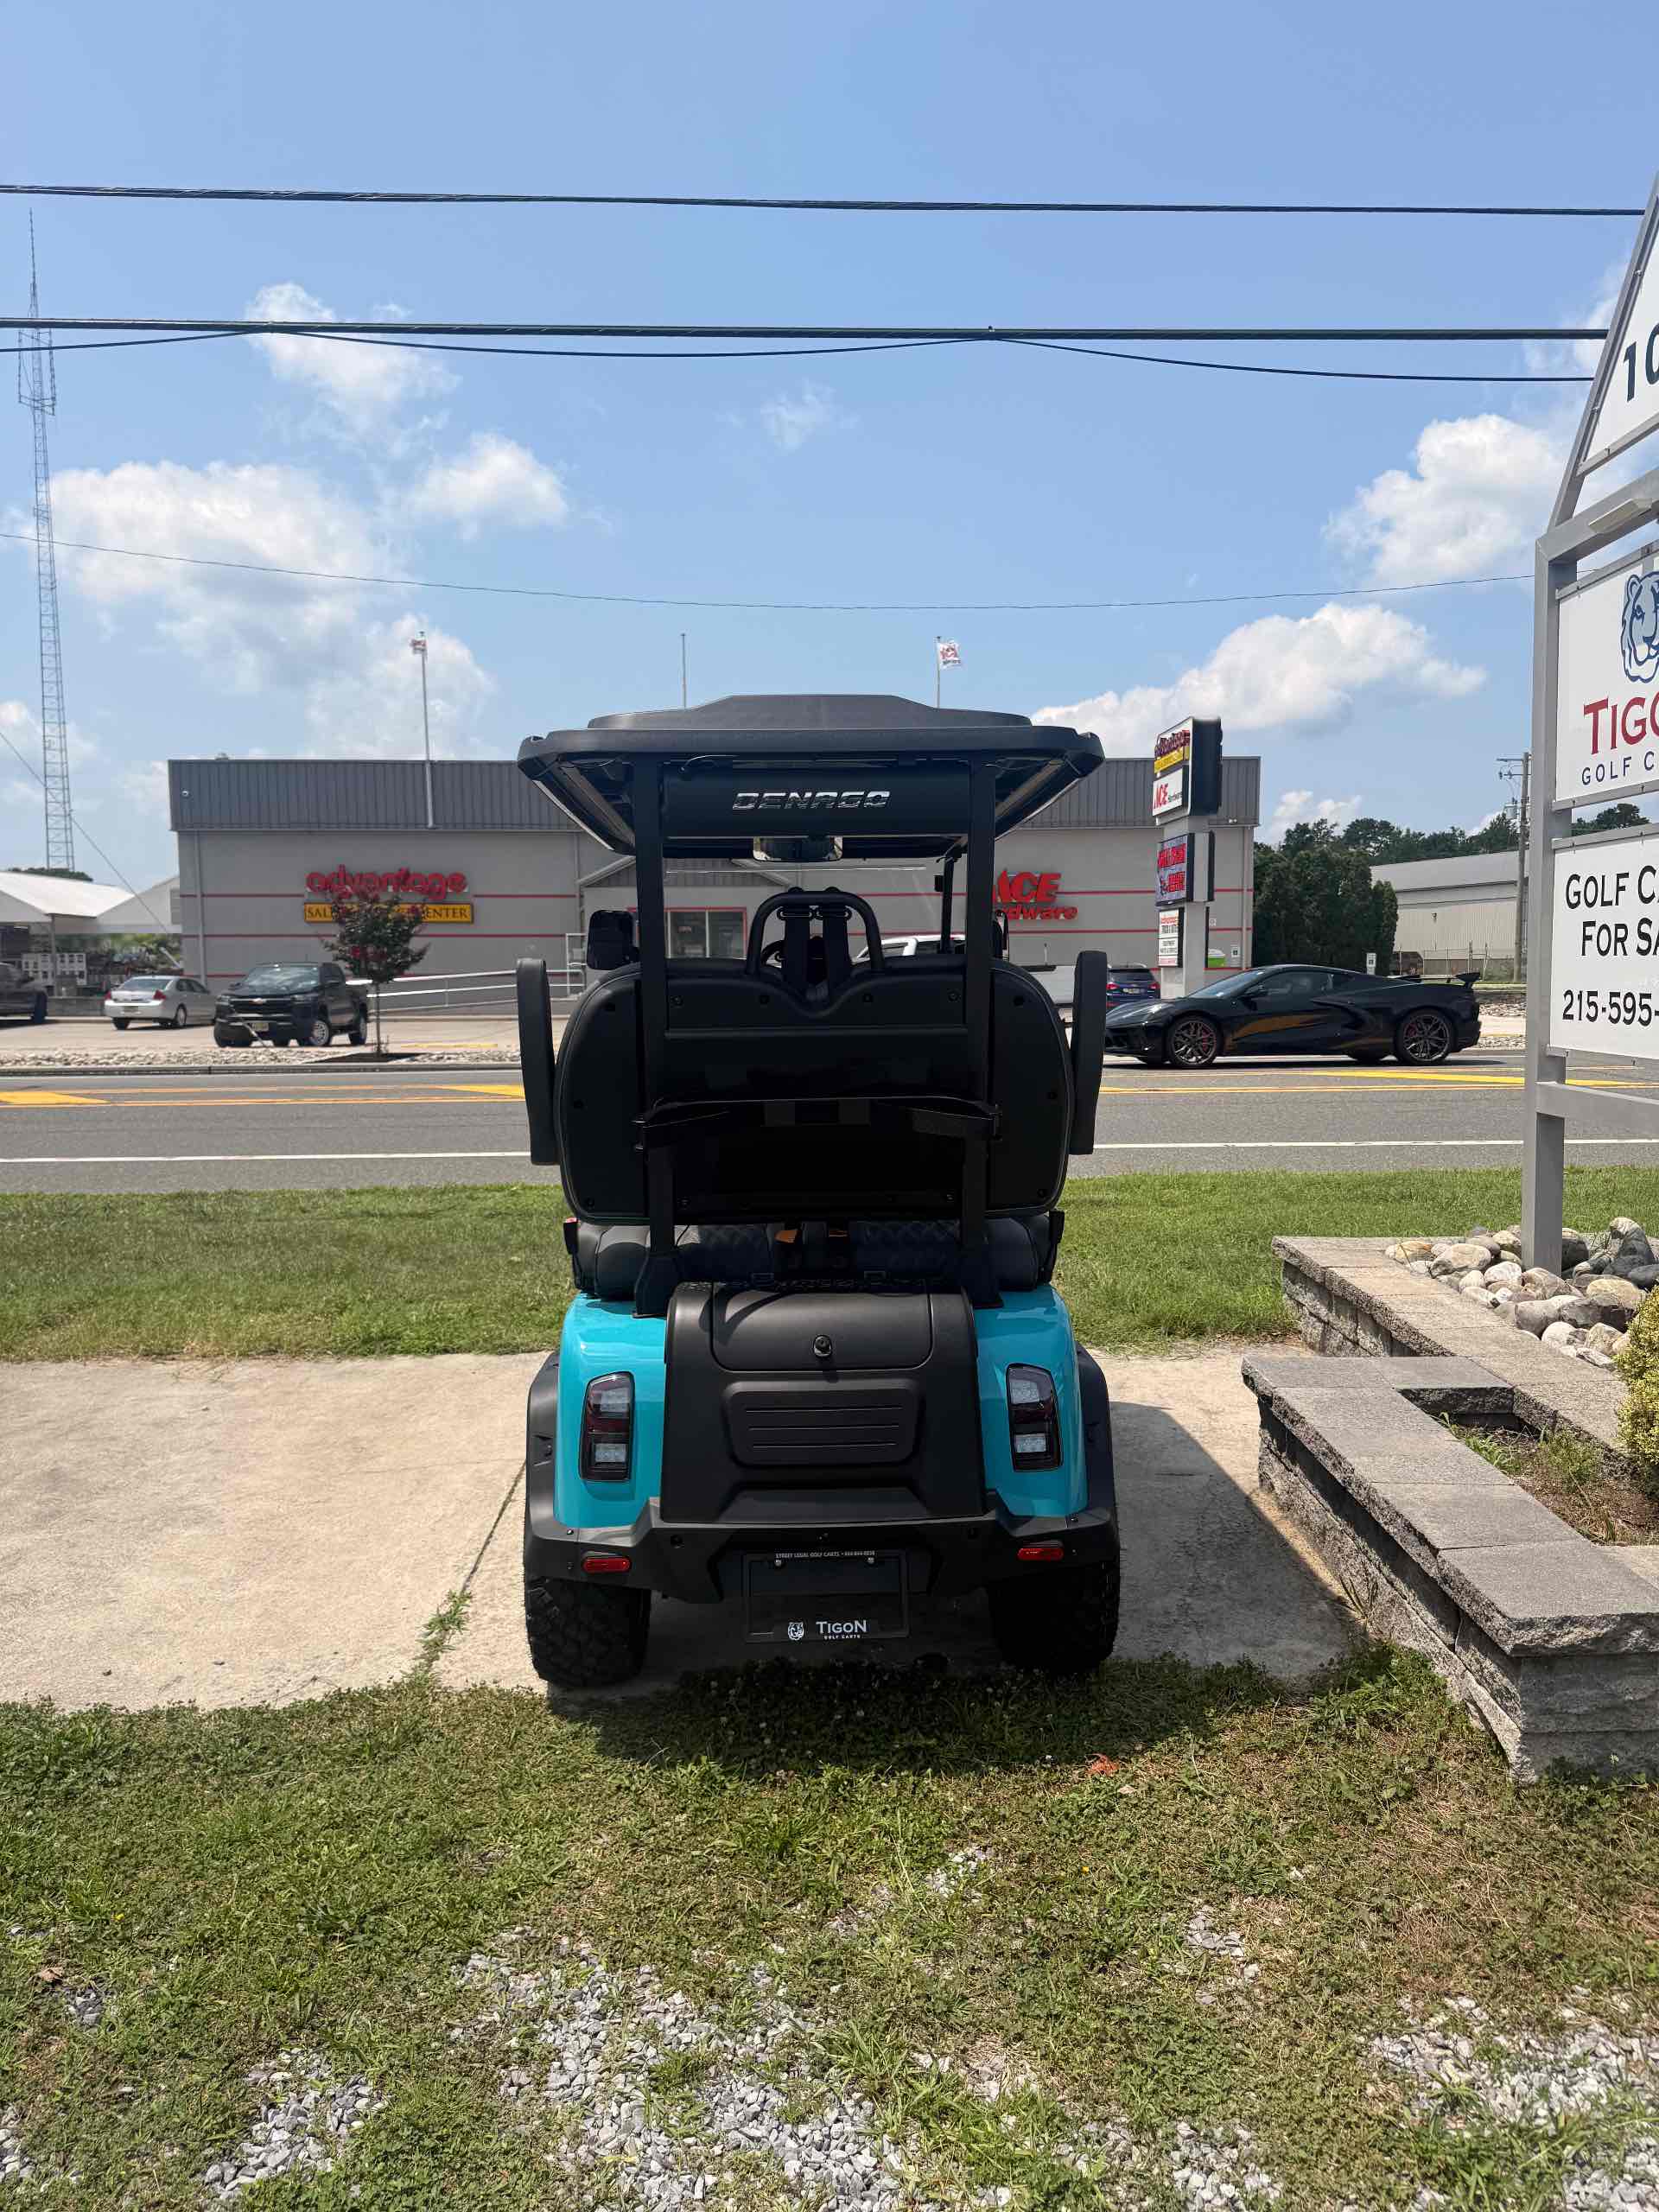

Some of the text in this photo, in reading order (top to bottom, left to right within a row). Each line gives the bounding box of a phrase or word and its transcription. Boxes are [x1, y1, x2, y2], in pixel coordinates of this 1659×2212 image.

[1581, 756, 1632, 786] GOLF
[732, 791, 890, 810] DENAGO
[305, 864, 468, 900] advantage
[992, 870, 1062, 904] ACE
[1565, 872, 1630, 910] GOLF
[422, 907, 468, 919] ENTER
[1581, 920, 1628, 957] FOR
[816, 1619, 867, 1634] TIGON
